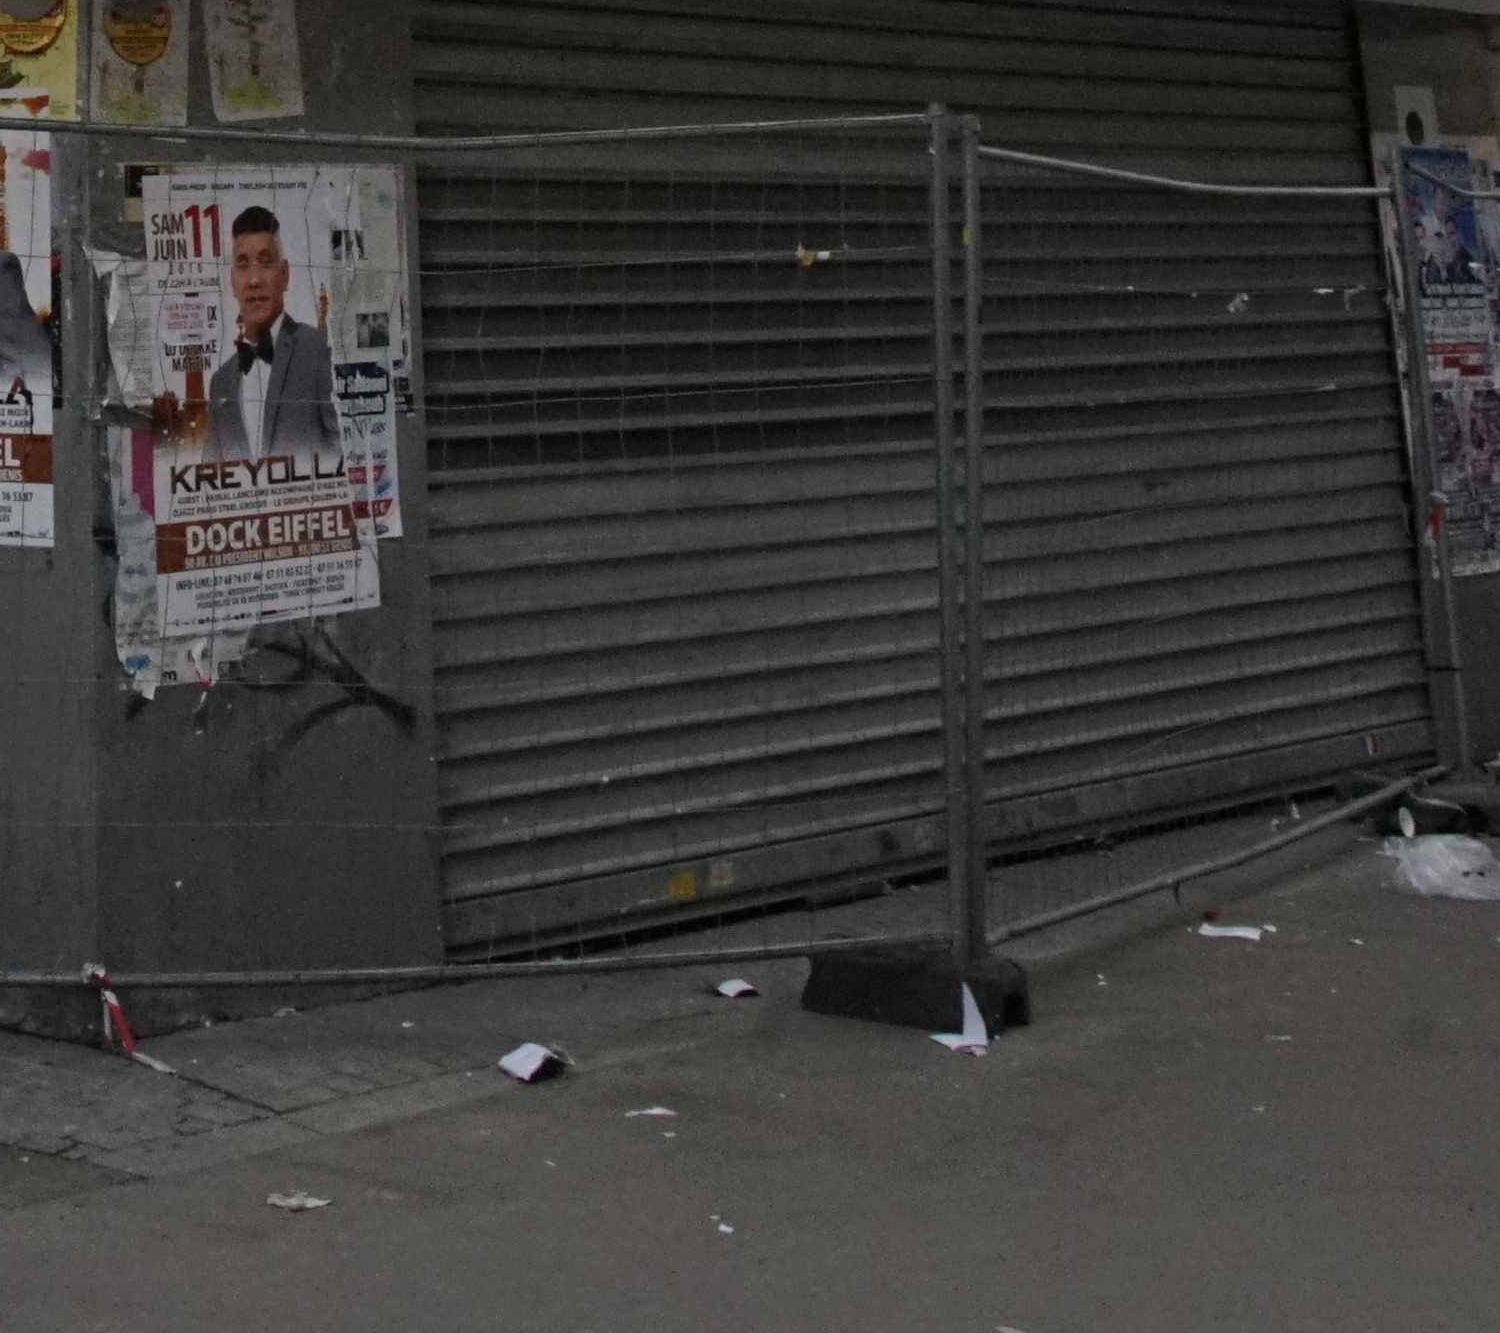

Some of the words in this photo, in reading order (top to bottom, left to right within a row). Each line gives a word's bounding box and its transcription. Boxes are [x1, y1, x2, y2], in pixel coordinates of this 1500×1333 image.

[151, 213, 185, 236] SAM
[184, 203, 221, 257] 11
[153, 238, 188, 261] JUIN
[185, 516, 262, 556] DOCK
[268, 510, 350, 545] EIFFEL
